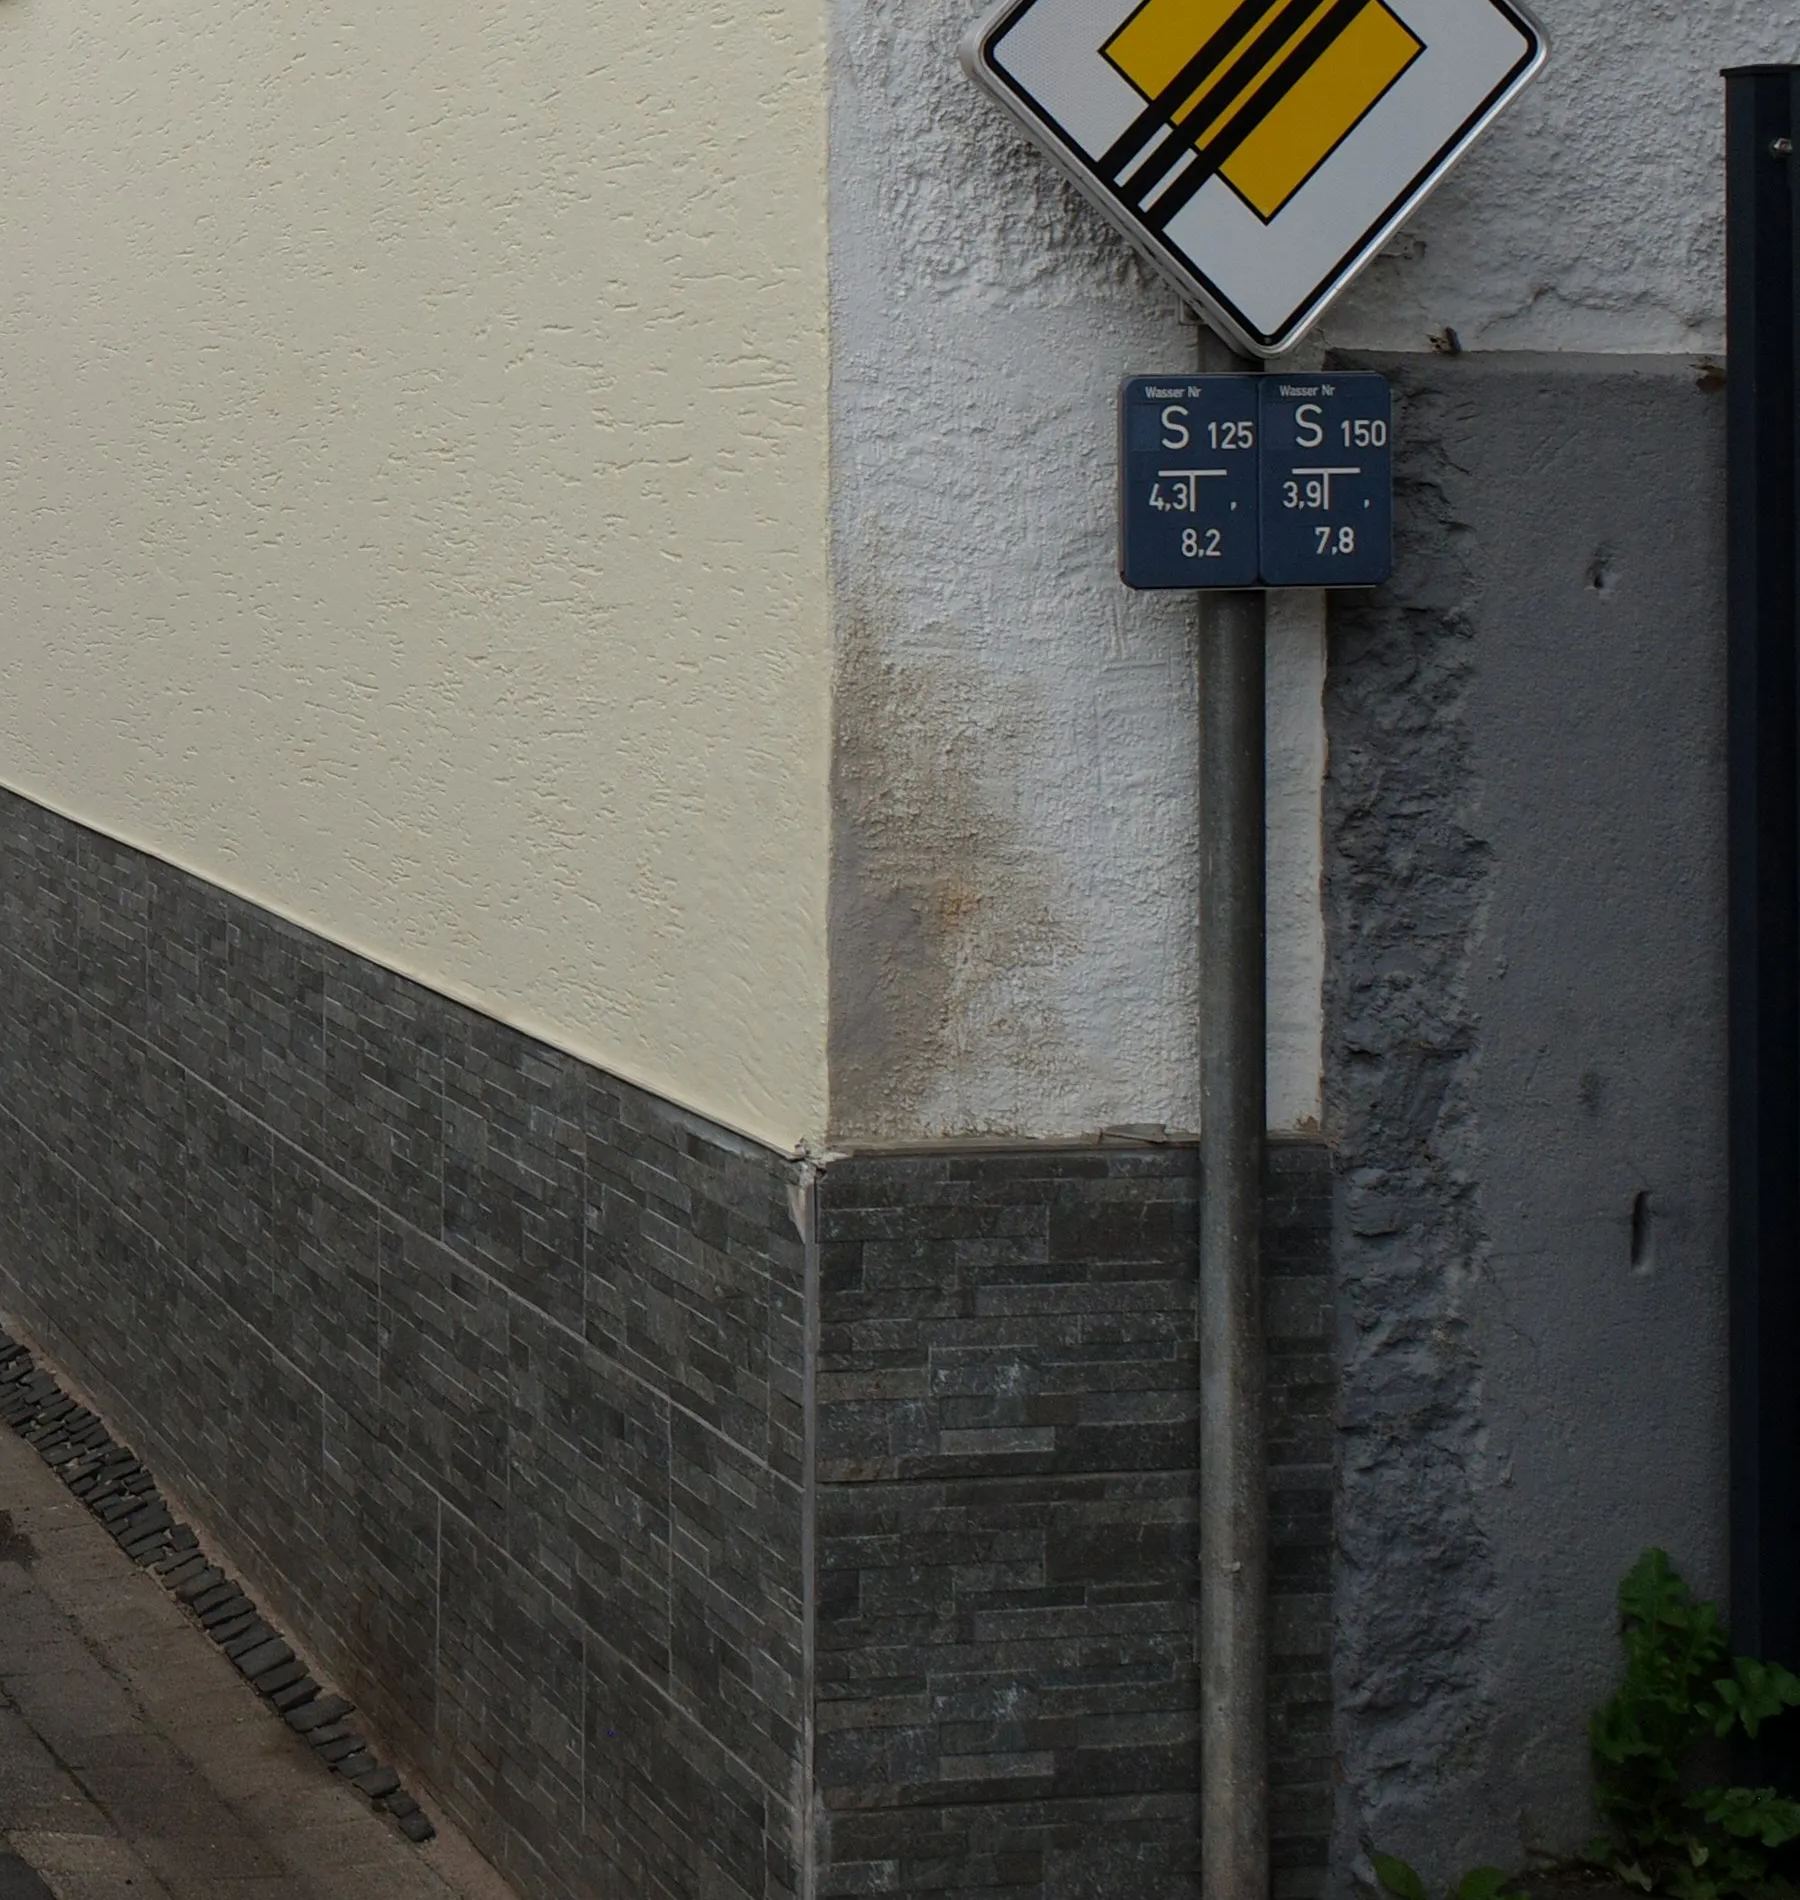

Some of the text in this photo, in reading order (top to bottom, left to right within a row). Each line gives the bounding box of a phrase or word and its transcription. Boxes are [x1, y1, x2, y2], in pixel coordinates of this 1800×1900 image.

[1145, 385, 1203, 399] Wasser Nr
[1279, 384, 1336, 397] Wasser Nr
[1161, 404, 1253, 450] S 125
[1295, 403, 1386, 448] S 150
[1181, 528, 1222, 558] 8,2
[1314, 526, 1355, 555] 7,8
